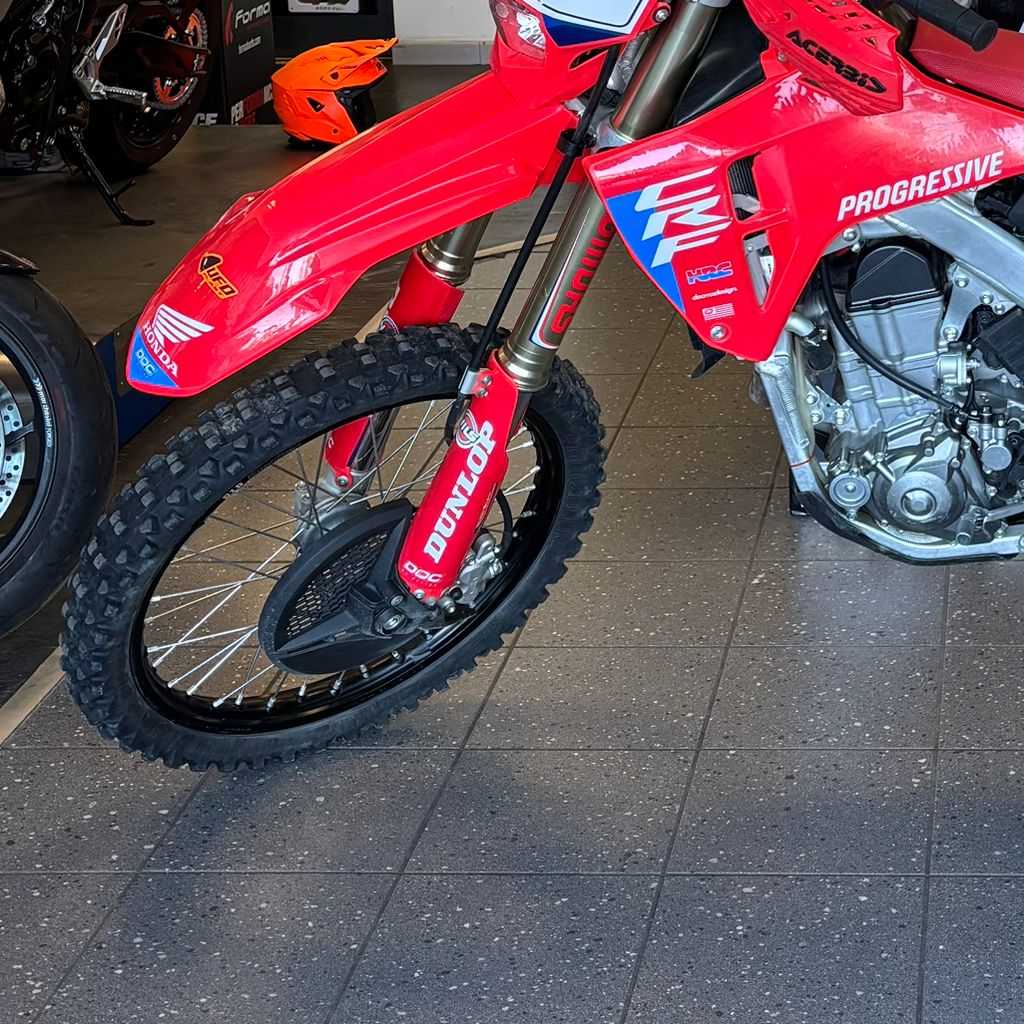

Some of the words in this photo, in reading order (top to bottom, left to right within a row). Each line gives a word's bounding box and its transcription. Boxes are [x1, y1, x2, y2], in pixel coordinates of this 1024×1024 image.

[836, 150, 1004, 223] PROGRESSIVE
[685, 260, 734, 286] HRC
[142, 320, 178, 378] HONDA
[423, 418, 498, 564] DUNLOP
